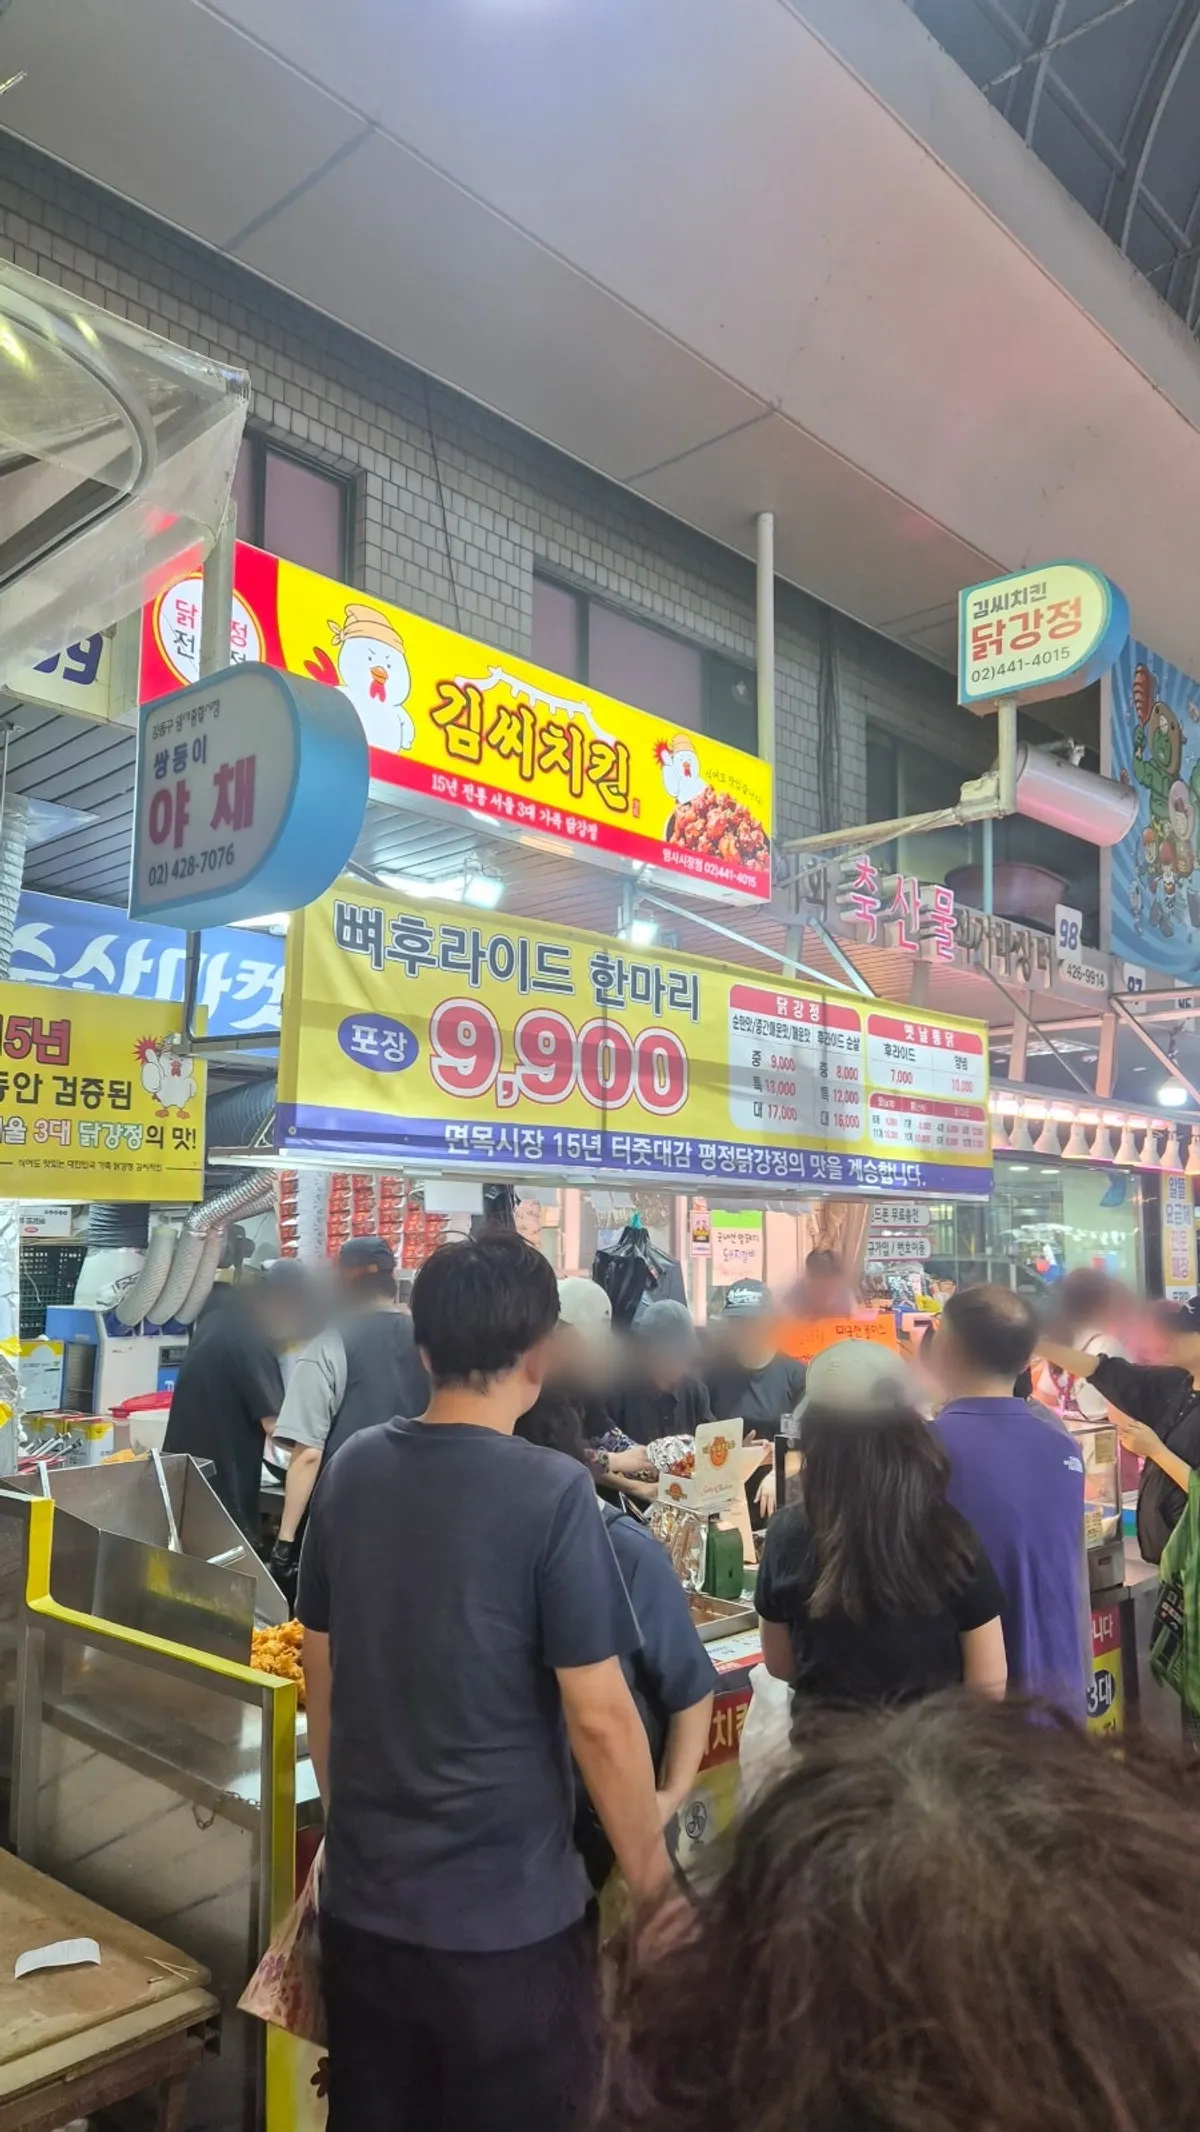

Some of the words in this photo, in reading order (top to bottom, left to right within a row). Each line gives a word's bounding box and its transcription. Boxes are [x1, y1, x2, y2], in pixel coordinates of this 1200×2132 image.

[973, 581, 1047, 620] 김씨치킨
[971, 596, 1082, 662] 닭강정
[971, 646, 1070, 683] 02)441-4015
[153, 733, 208, 780] 쌍둥이
[430, 680, 631, 813] 김씨치킨
[431, 773, 458, 797] 15년
[462, 783, 488, 807] 전통
[490, 792, 515, 815] 서울
[539, 808, 563, 830] 가족
[565, 816, 598, 841] 닭강정
[171, 843, 235, 880] 428-7076
[704, 861, 757, 888] 02)441-4015
[850, 854, 957, 963] 축산물
[1059, 918, 1080, 951] 98
[334, 899, 575, 997] 뼈후라이드
[588, 952, 700, 1024] 한마리
[1066, 962, 1105, 988] 426-9914
[777, 996, 820, 1022] 닭강정
[0, 1014, 71, 1066] 5년
[351, 1024, 408, 1063] 포장
[429, 996, 690, 1117] 9,900
[751, 1050, 761, 1068] 중
[770, 1055, 796, 1072] 9,000
[819, 1062, 828, 1079] 중
[836, 1066, 859, 1081] 8,000
[890, 1069, 914, 1085] 7,000
[52, 1075, 132, 1111] 검증된
[765, 1080, 796, 1097] 13,000
[832, 1089, 860, 1105] 12,000
[753, 1101, 763, 1118] 대
[767, 1103, 798, 1121] 17,000
[820, 1110, 829, 1127] 대
[0, 1115, 28, 1146] 울
[33, 1118, 72, 1147] 3대
[77, 1120, 165, 1151] 닭강정의
[172, 1127, 197, 1151] 맛!
[444, 1123, 545, 1160] 면목시장
[553, 1132, 603, 1163] 15년
[611, 1136, 692, 1168] 터줏대감
[810, 1155, 843, 1180] 맛을
[847, 1158, 927, 1187] 계승합니다.
[1086, 1672, 1112, 1713] 3대
